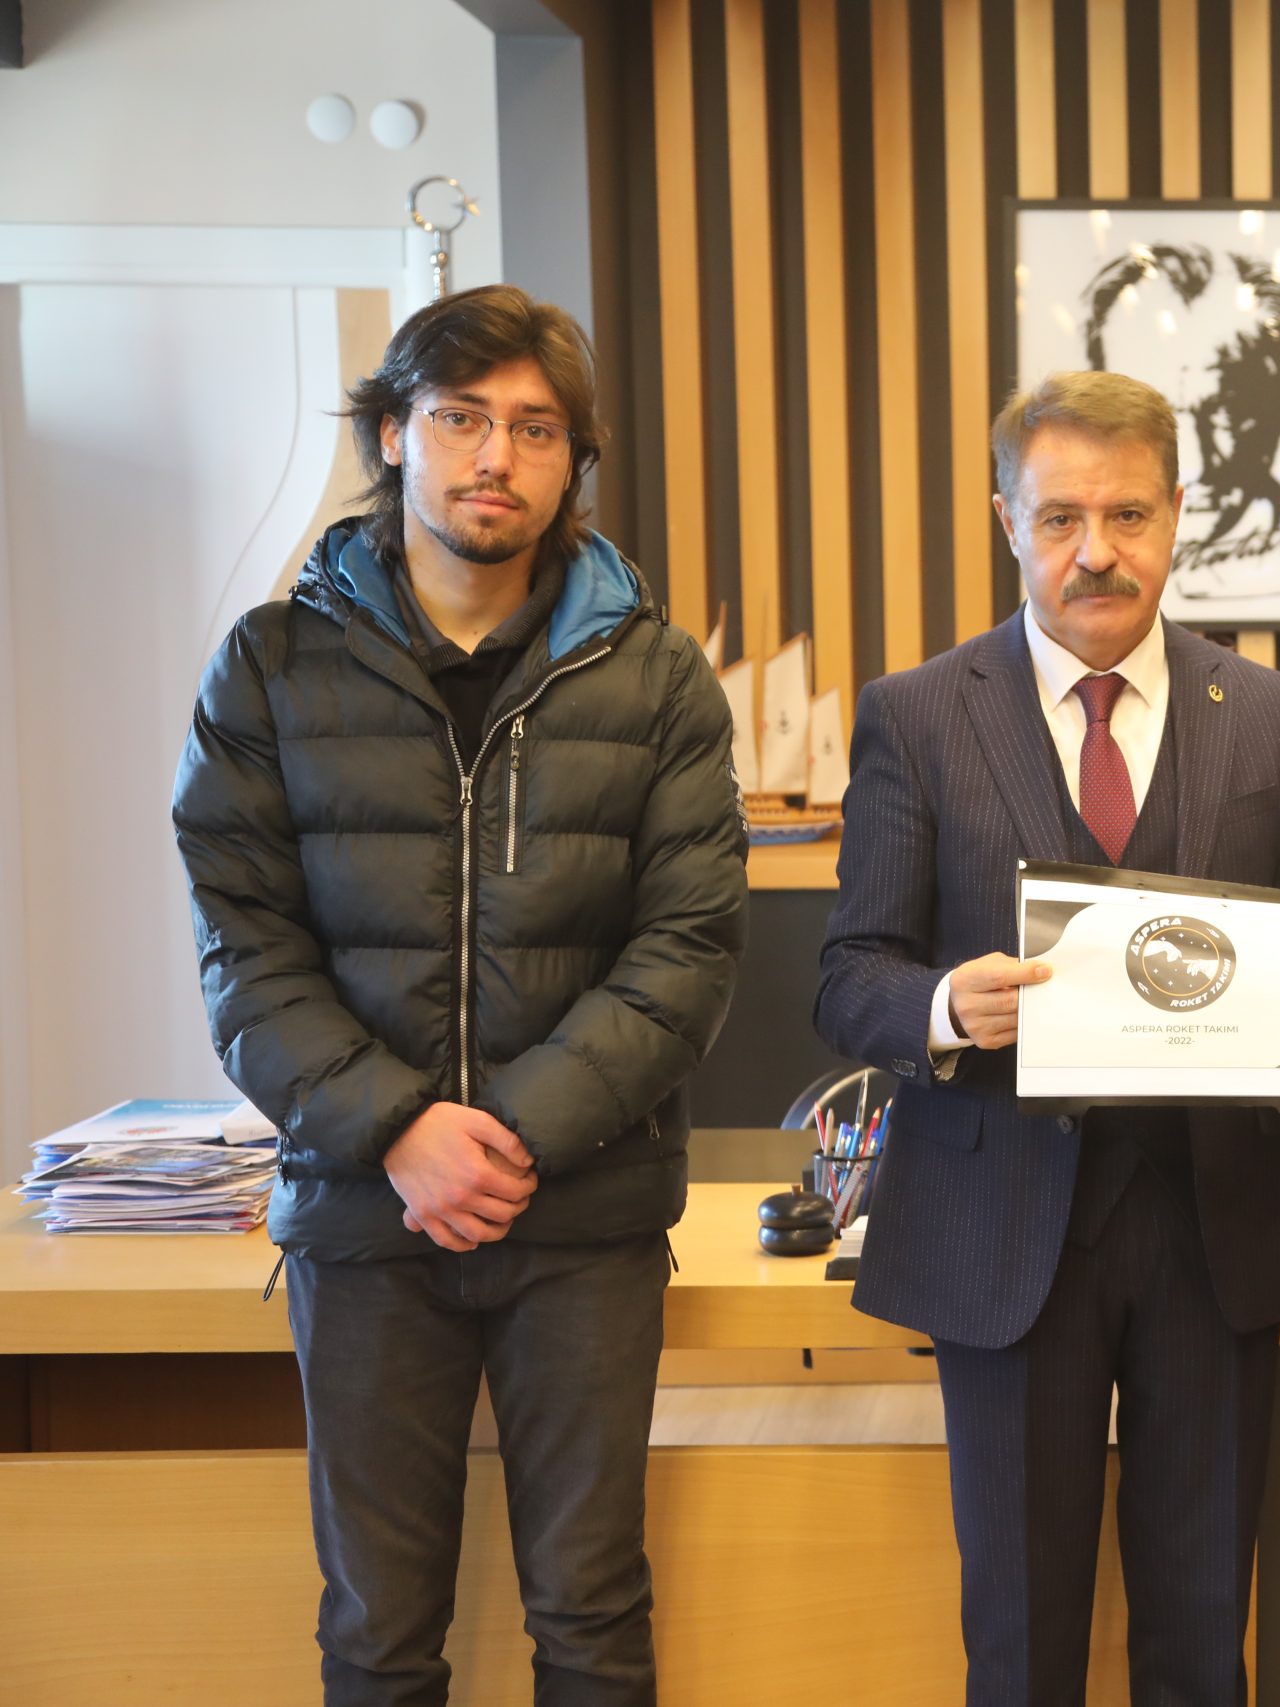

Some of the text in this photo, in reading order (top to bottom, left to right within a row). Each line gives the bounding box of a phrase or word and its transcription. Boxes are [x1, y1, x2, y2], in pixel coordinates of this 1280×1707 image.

[1131, 917, 1182, 956] ASPERA
[1170, 958, 1231, 1007] ROKET TAKIMI
[1121, 1025, 1239, 1033] ASPERA ROKET TAKIMI
